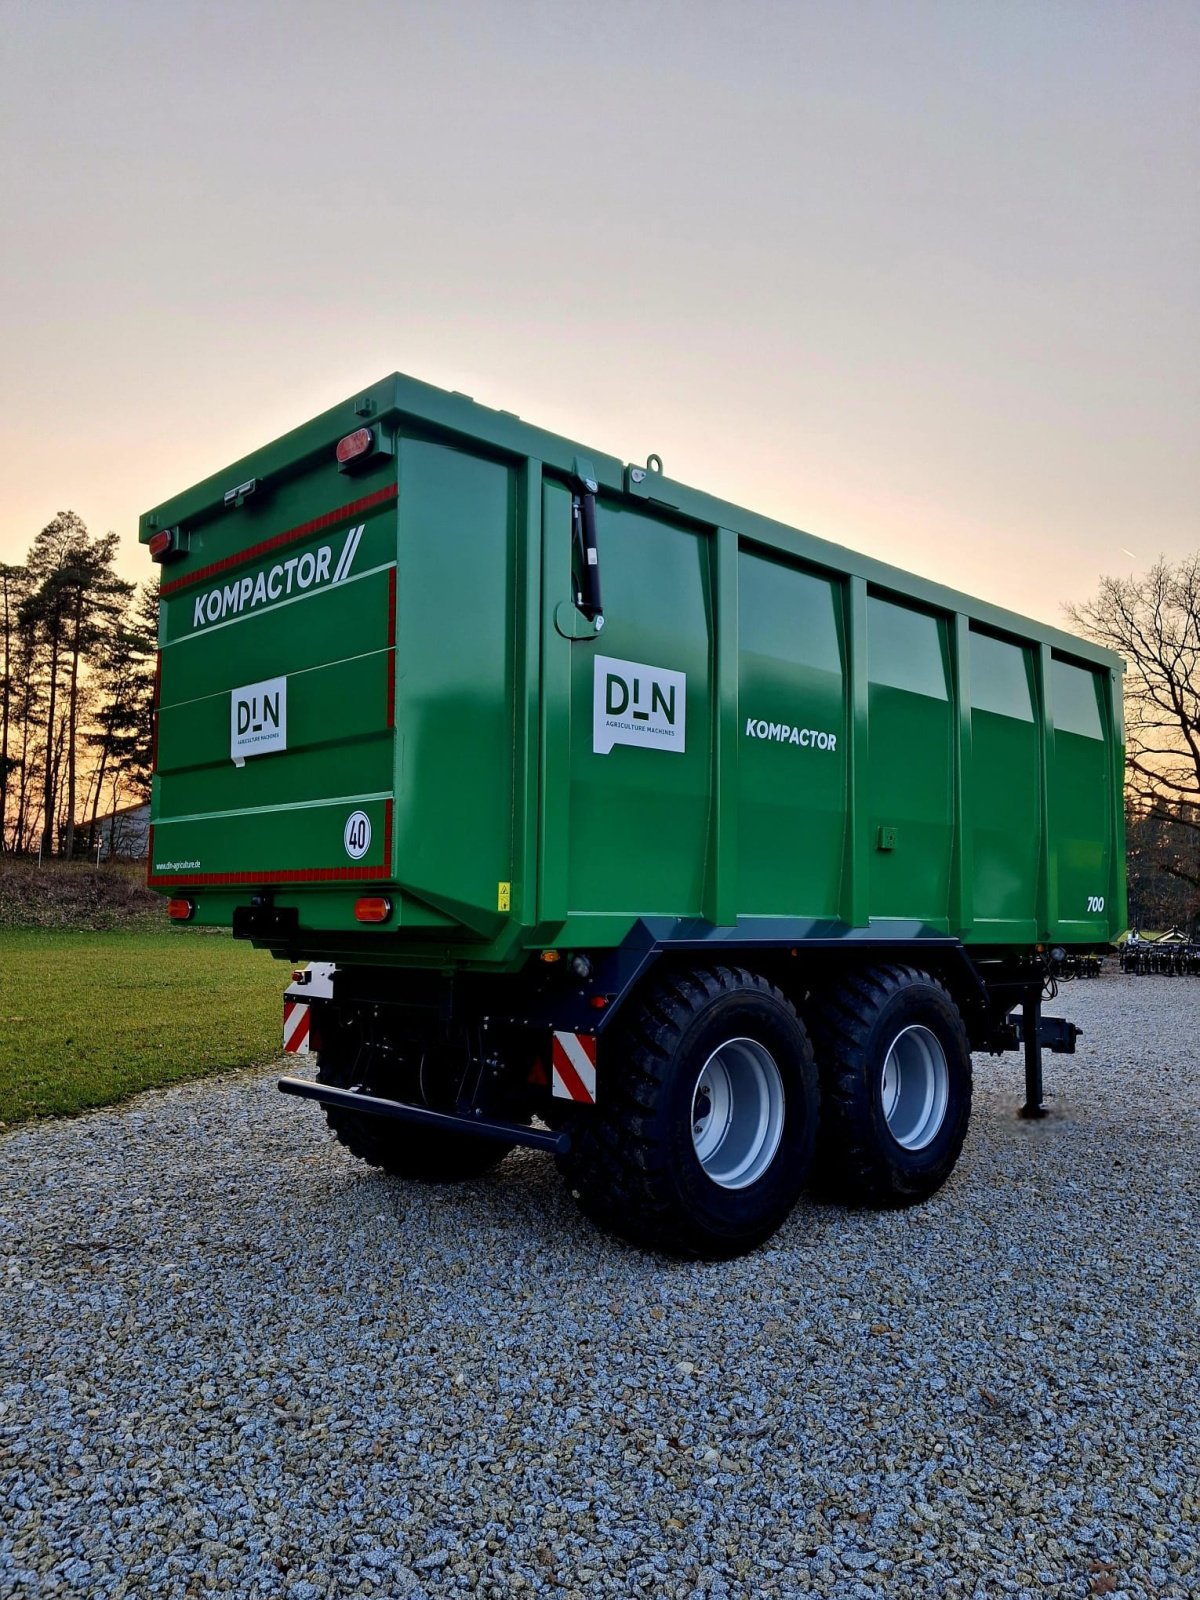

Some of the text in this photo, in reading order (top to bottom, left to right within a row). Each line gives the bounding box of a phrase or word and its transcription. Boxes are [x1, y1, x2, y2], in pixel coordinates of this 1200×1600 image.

[605, 720, 676, 737] AGRICULTURE MACHINES
[745, 718, 837, 752] KOMPACTOR
[348, 819, 366, 850] 40
[1086, 896, 1105, 913] 700
